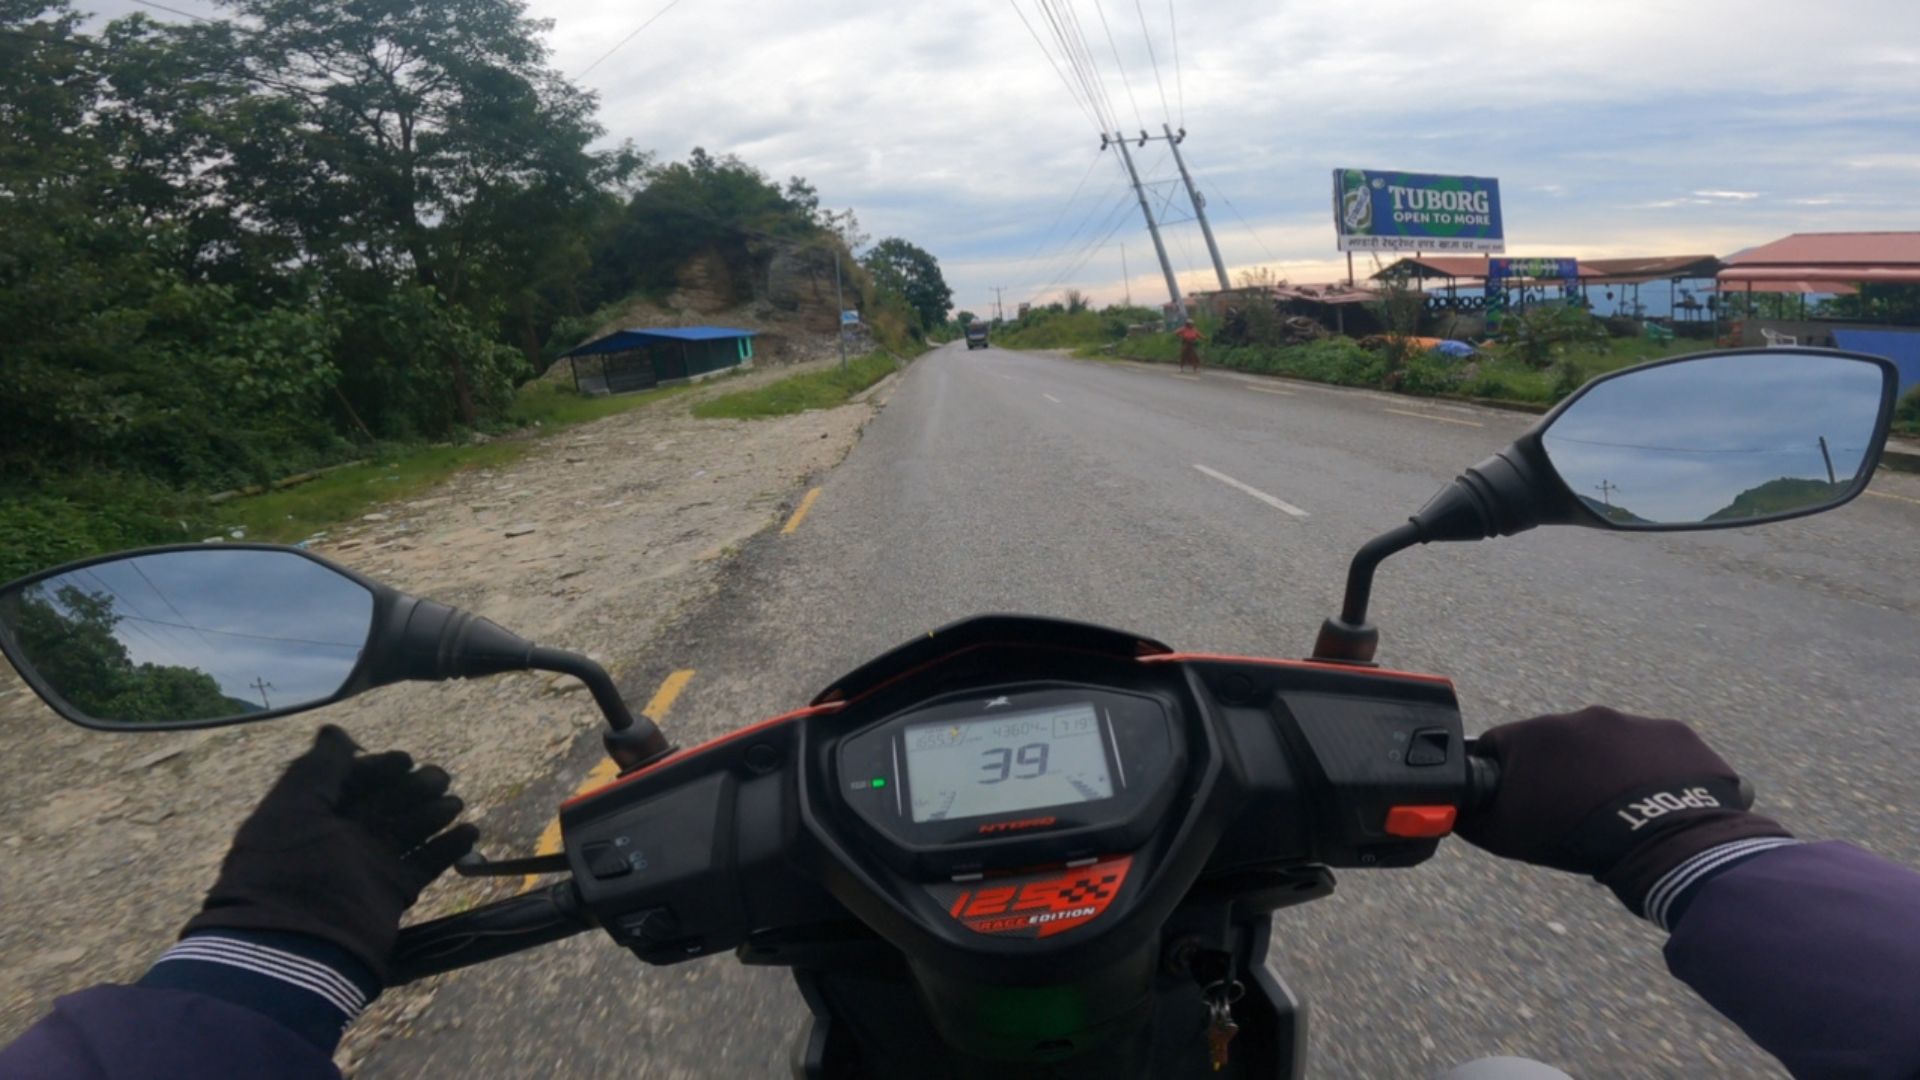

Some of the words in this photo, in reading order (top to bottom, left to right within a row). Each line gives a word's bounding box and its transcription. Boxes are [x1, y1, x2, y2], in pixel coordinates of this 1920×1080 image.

[1388, 185, 1490, 212] TUBORG
[1393, 211, 1430, 224] OPEN
[1433, 212, 1451, 224] TO
[1454, 214, 1490, 225] MORE
[978, 743, 1050, 785] 39
[1617, 787, 1721, 831] SPORT
[949, 882, 1059, 919] 125
[1028, 907, 1096, 924] EDITION
